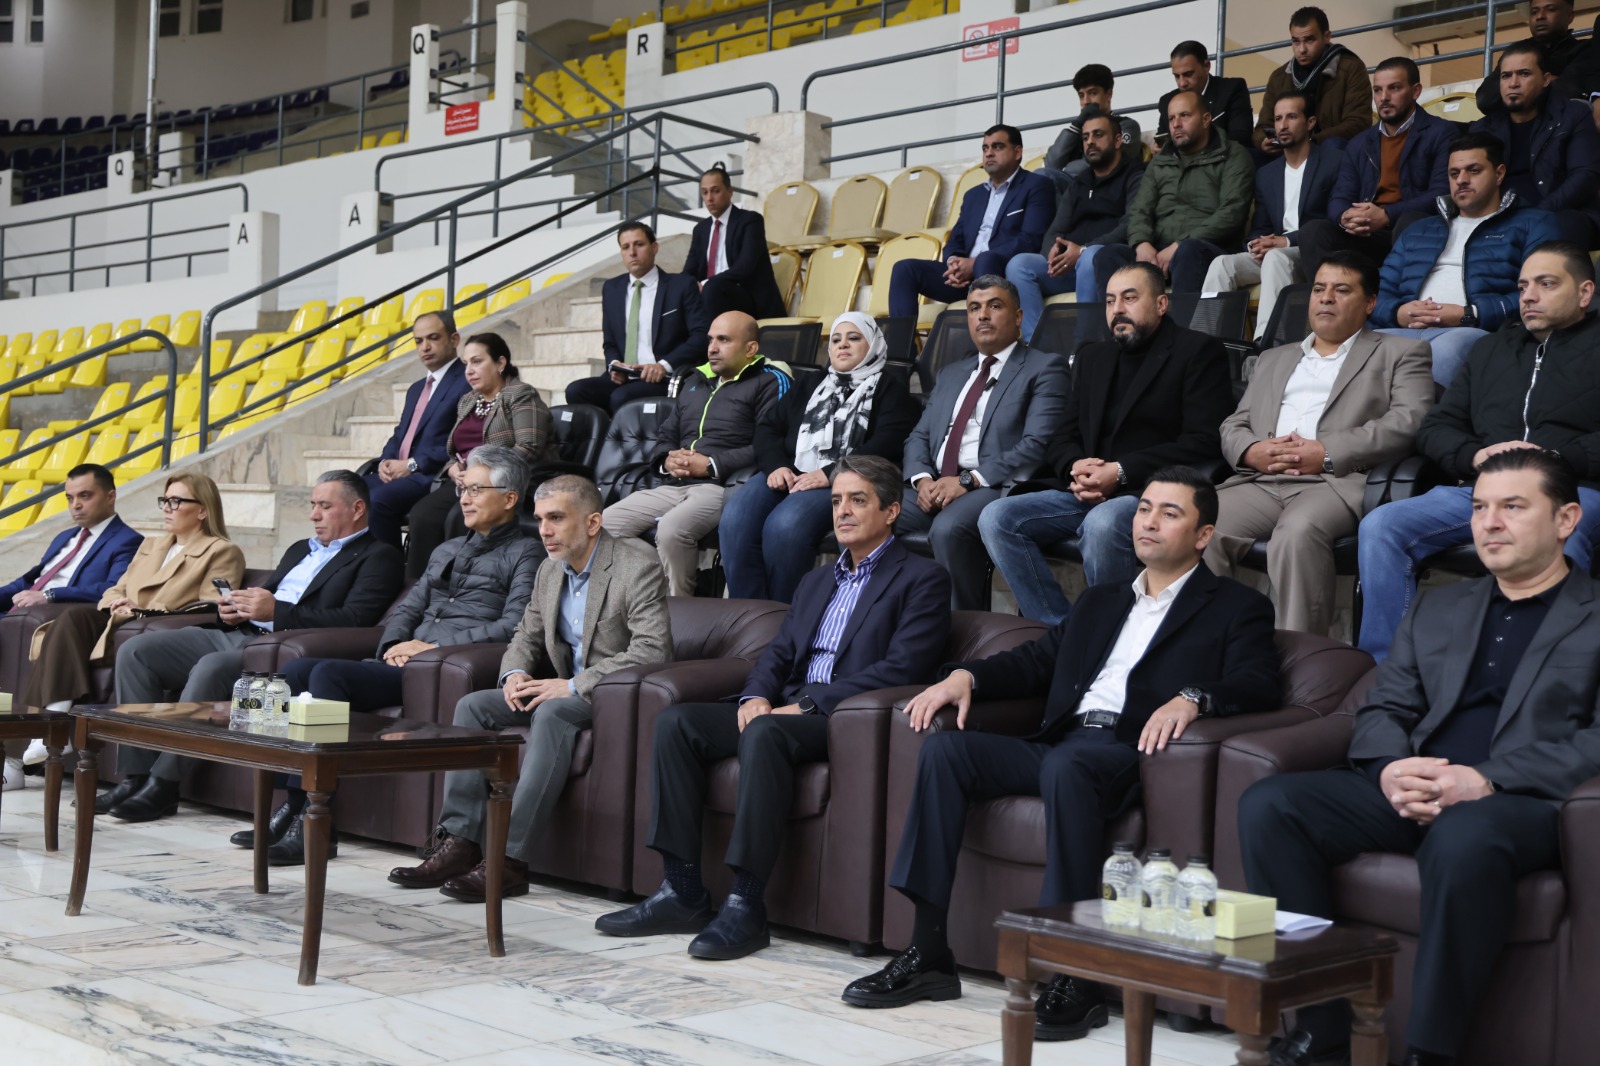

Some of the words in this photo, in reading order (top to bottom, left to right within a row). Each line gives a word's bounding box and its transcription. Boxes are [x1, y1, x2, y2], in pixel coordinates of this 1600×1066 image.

[412, 33, 425, 55] Q
[637, 33, 649, 56] R
[115, 158, 124, 176] Q
[348, 204, 361, 227] A
[237, 223, 249, 245] A
